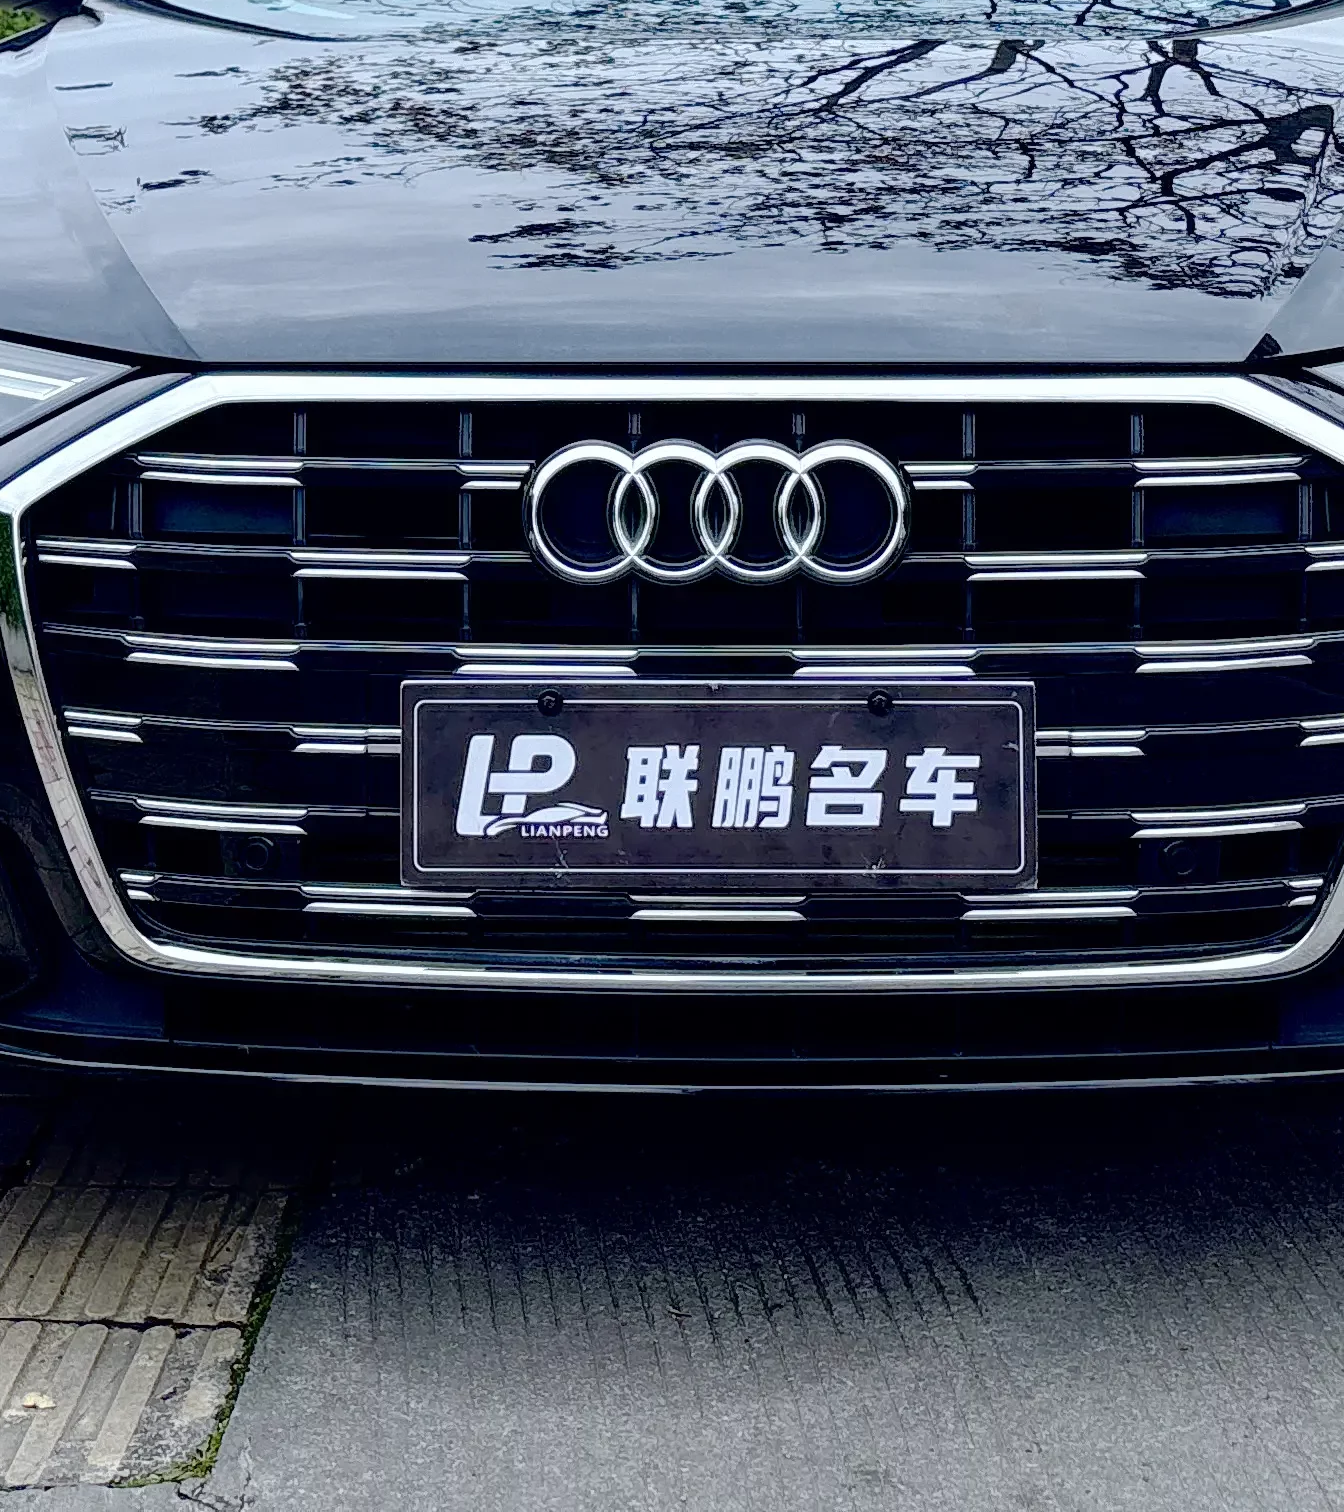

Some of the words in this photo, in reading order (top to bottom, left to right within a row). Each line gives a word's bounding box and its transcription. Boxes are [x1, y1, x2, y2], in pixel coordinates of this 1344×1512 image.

[620, 744, 982, 828] 联鹏名车
[520, 824, 610, 838] LIANPENG
